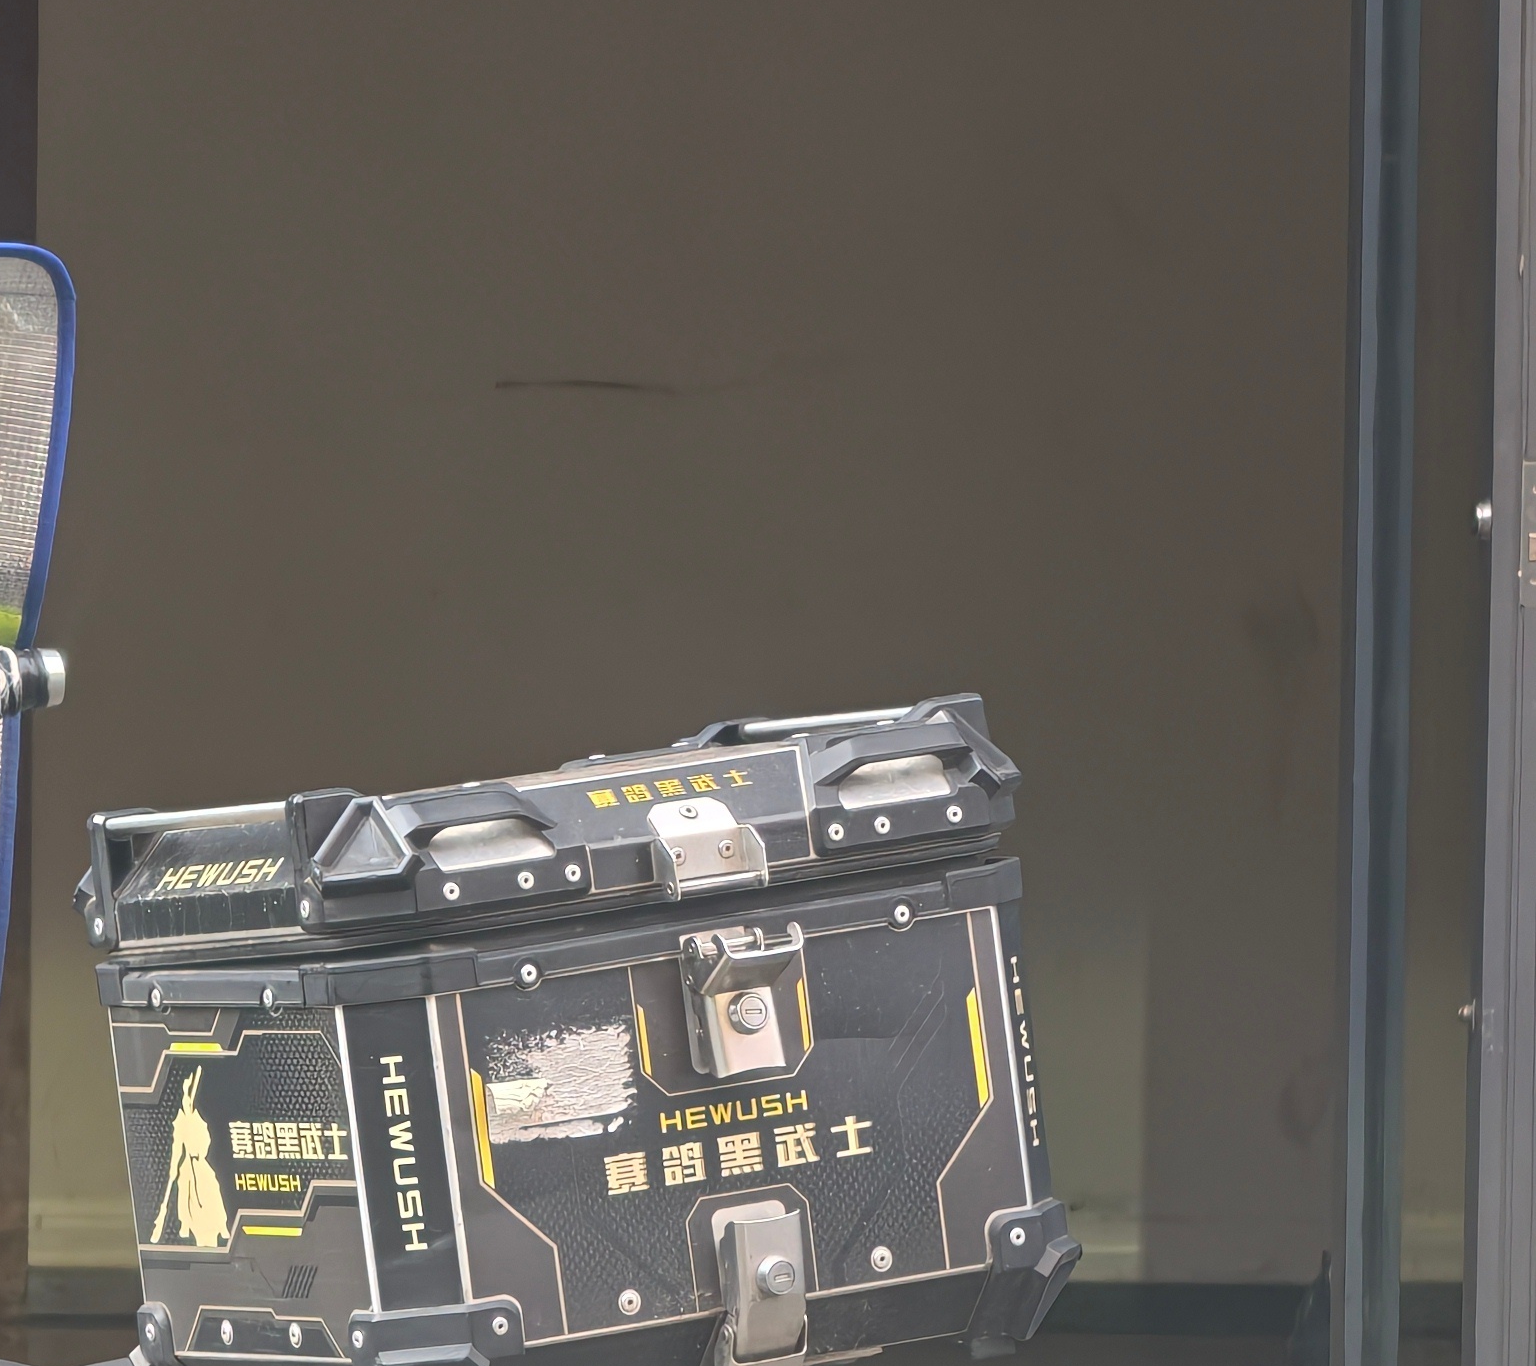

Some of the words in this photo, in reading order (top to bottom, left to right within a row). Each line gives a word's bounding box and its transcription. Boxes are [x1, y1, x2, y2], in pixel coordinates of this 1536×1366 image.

[155, 856, 285, 892] HEWUSH
[1010, 955, 1040, 1147] HEWUSH
[659, 1089, 808, 1134] HEWUSH
[228, 1121, 349, 1160] 赛鸽黑武士
[379, 1055, 429, 1252] HEWUSH
[603, 1115, 874, 1196] 赛鸽黑武士
[234, 1173, 302, 1192] HEWUSH
